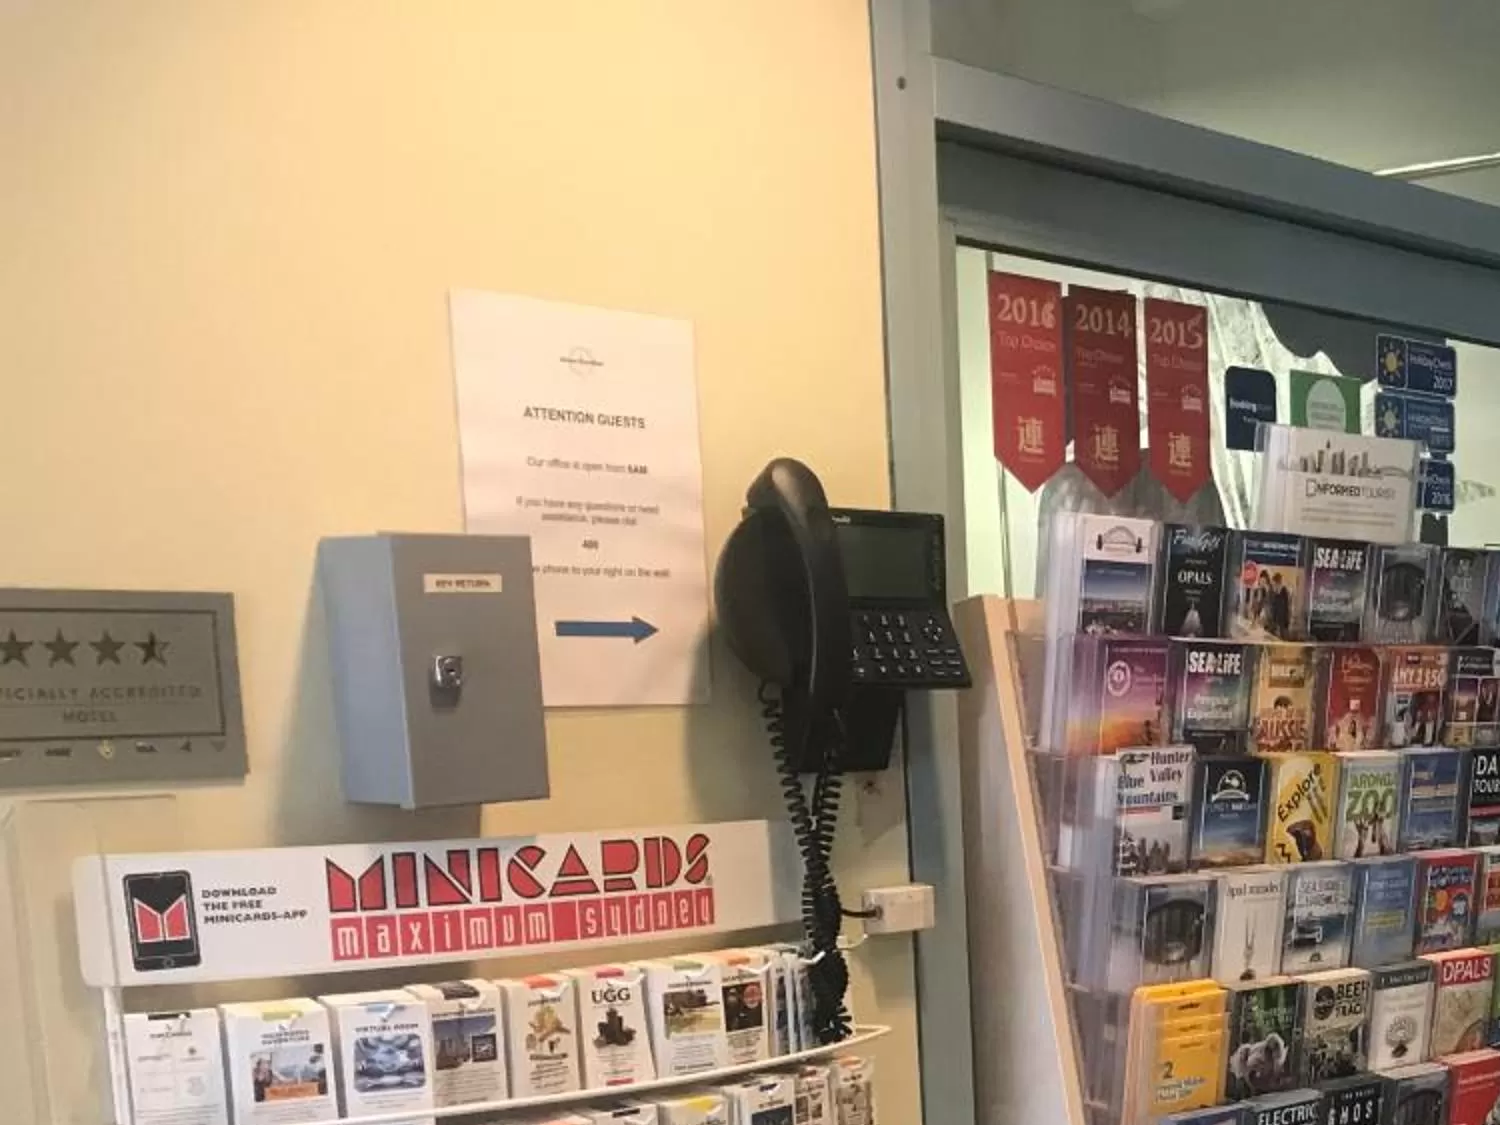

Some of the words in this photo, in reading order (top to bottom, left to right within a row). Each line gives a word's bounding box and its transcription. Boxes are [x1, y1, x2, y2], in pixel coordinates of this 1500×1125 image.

[998, 293, 1057, 330] 2016
[1075, 303, 1133, 338] 2014
[998, 330, 1019, 350] Top
[1151, 314, 1204, 350] 2015
[523, 405, 595, 425] ATTENTION
[597, 413, 646, 429] GUESTS
[1188, 650, 1215, 673] SEA
[1150, 751, 1191, 766] Hunter
[1149, 766, 1184, 783] Valley
[325, 833, 711, 913] MINICARDS
[201, 886, 278, 899] DOWNLOAD
[203, 902, 229, 911] THE
[232, 900, 263, 909] FREE
[204, 909, 308, 924] MINICARDS-APP
[336, 909, 549, 957] maximum
[586, 898, 710, 936] sydney
[1442, 956, 1490, 983] OPALS
[591, 987, 631, 1004] UGG
